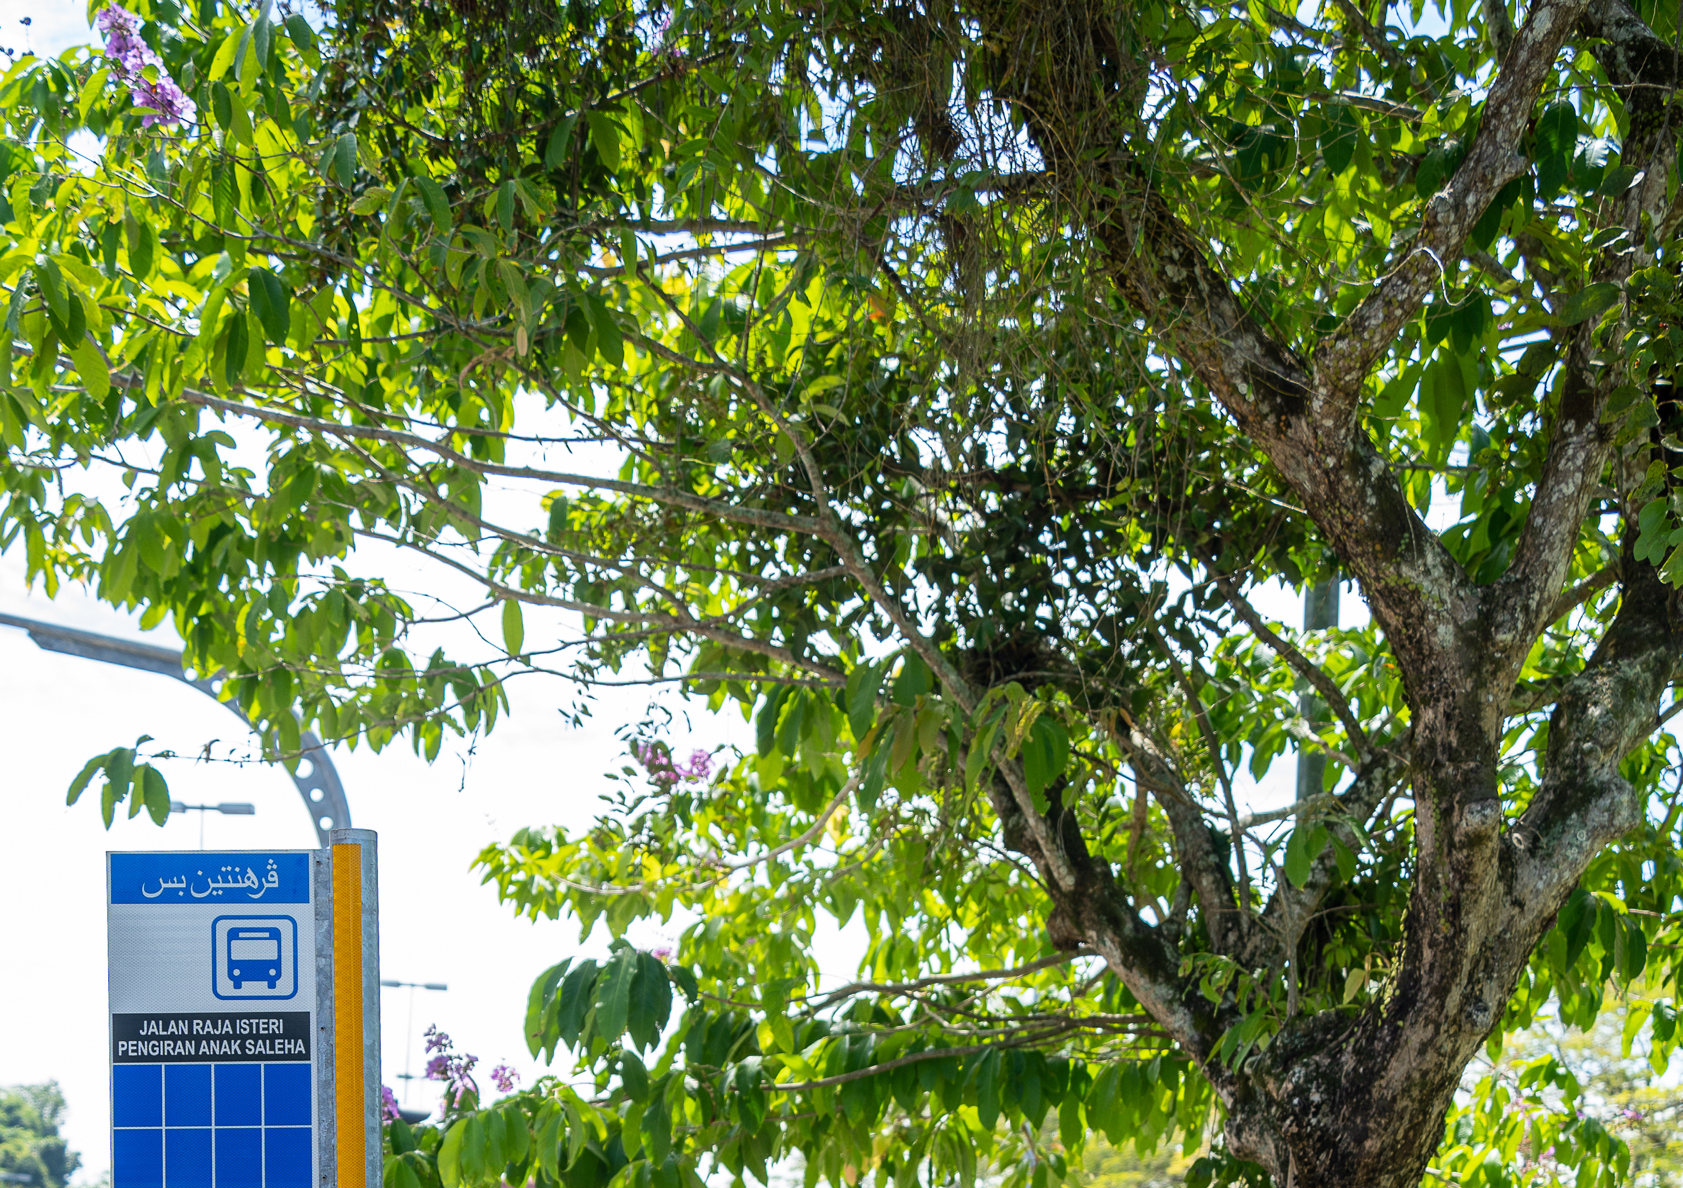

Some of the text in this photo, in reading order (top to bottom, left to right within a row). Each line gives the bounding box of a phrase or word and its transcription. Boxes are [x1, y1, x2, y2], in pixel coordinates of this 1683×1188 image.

[141, 874, 187, 899] بس
[139, 1018, 284, 1036] JALAN RAJA ISTERI
[118, 1038, 306, 1056] PENGIRAN ANAK SALEHA
